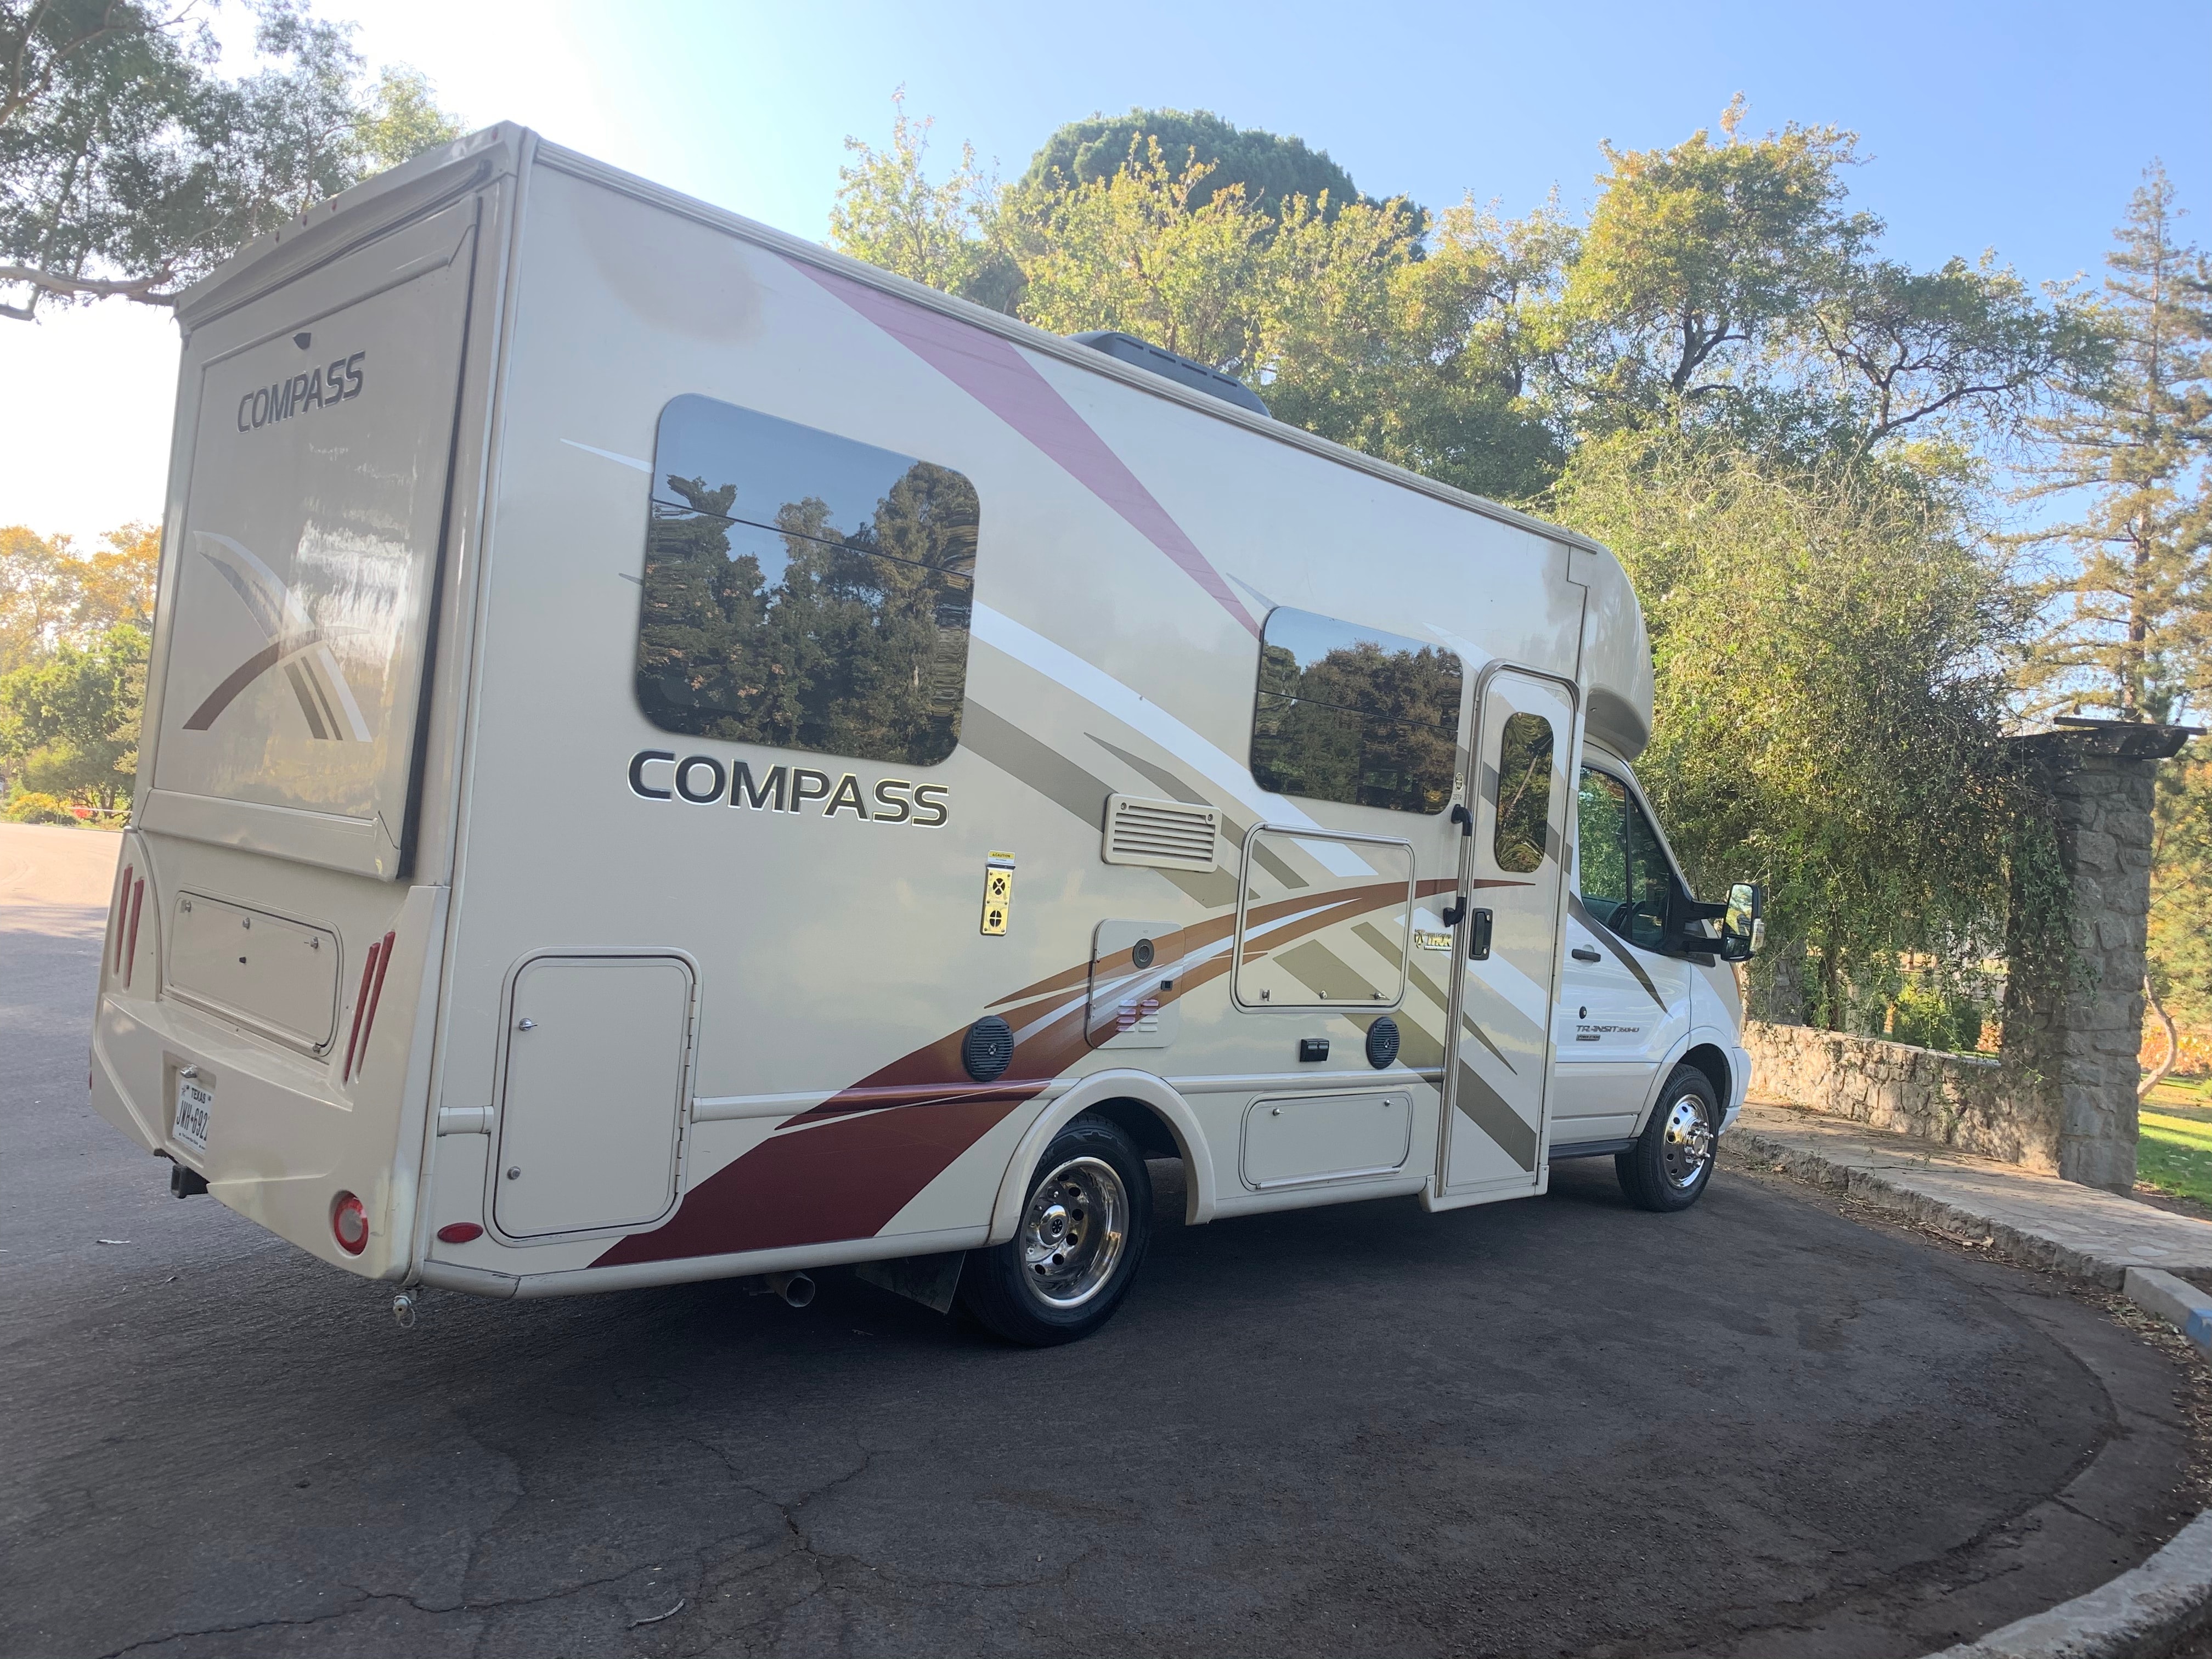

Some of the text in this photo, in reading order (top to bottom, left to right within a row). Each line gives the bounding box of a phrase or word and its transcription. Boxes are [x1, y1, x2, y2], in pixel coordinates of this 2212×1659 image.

[237, 350, 366, 433] COMPASS
[627, 748, 950, 828] COMPASS
[191, 1087, 206, 1104] TEXAS
